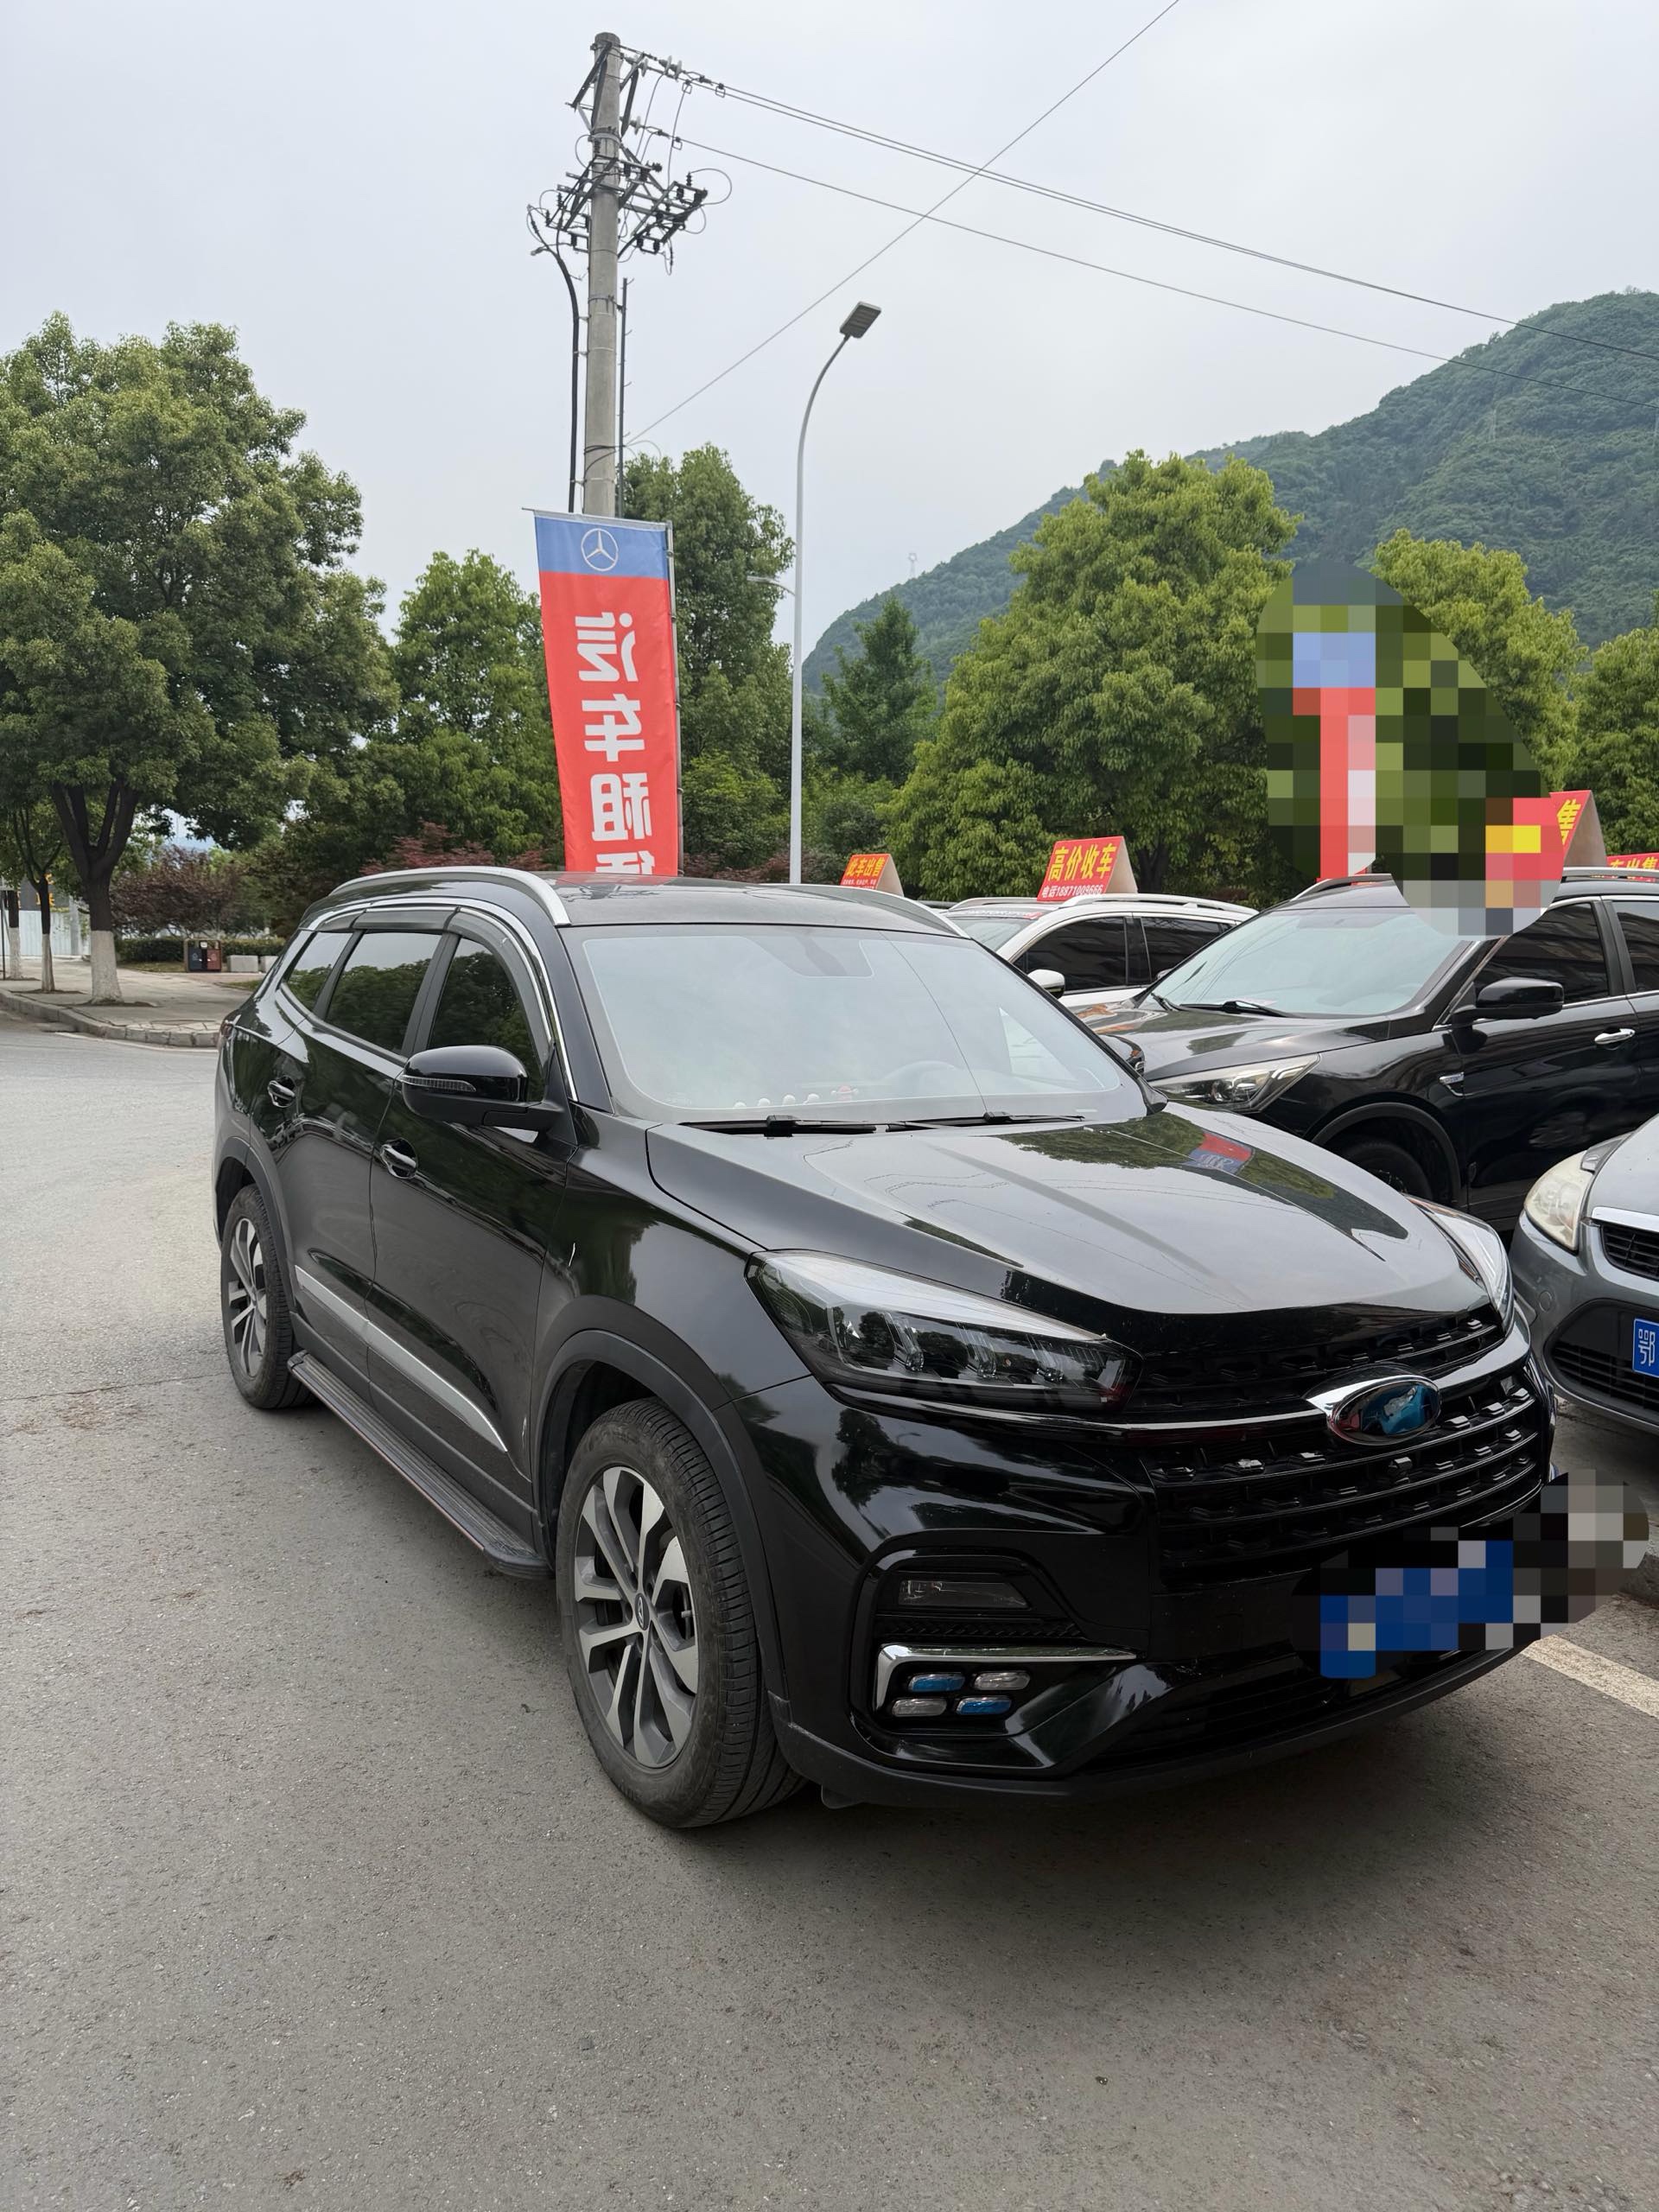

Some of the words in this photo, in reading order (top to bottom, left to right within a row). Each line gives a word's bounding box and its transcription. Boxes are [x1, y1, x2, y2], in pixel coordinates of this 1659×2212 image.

[1048, 843, 1117, 881] 高价收车
[1638, 1329, 1656, 1367] 鄂
